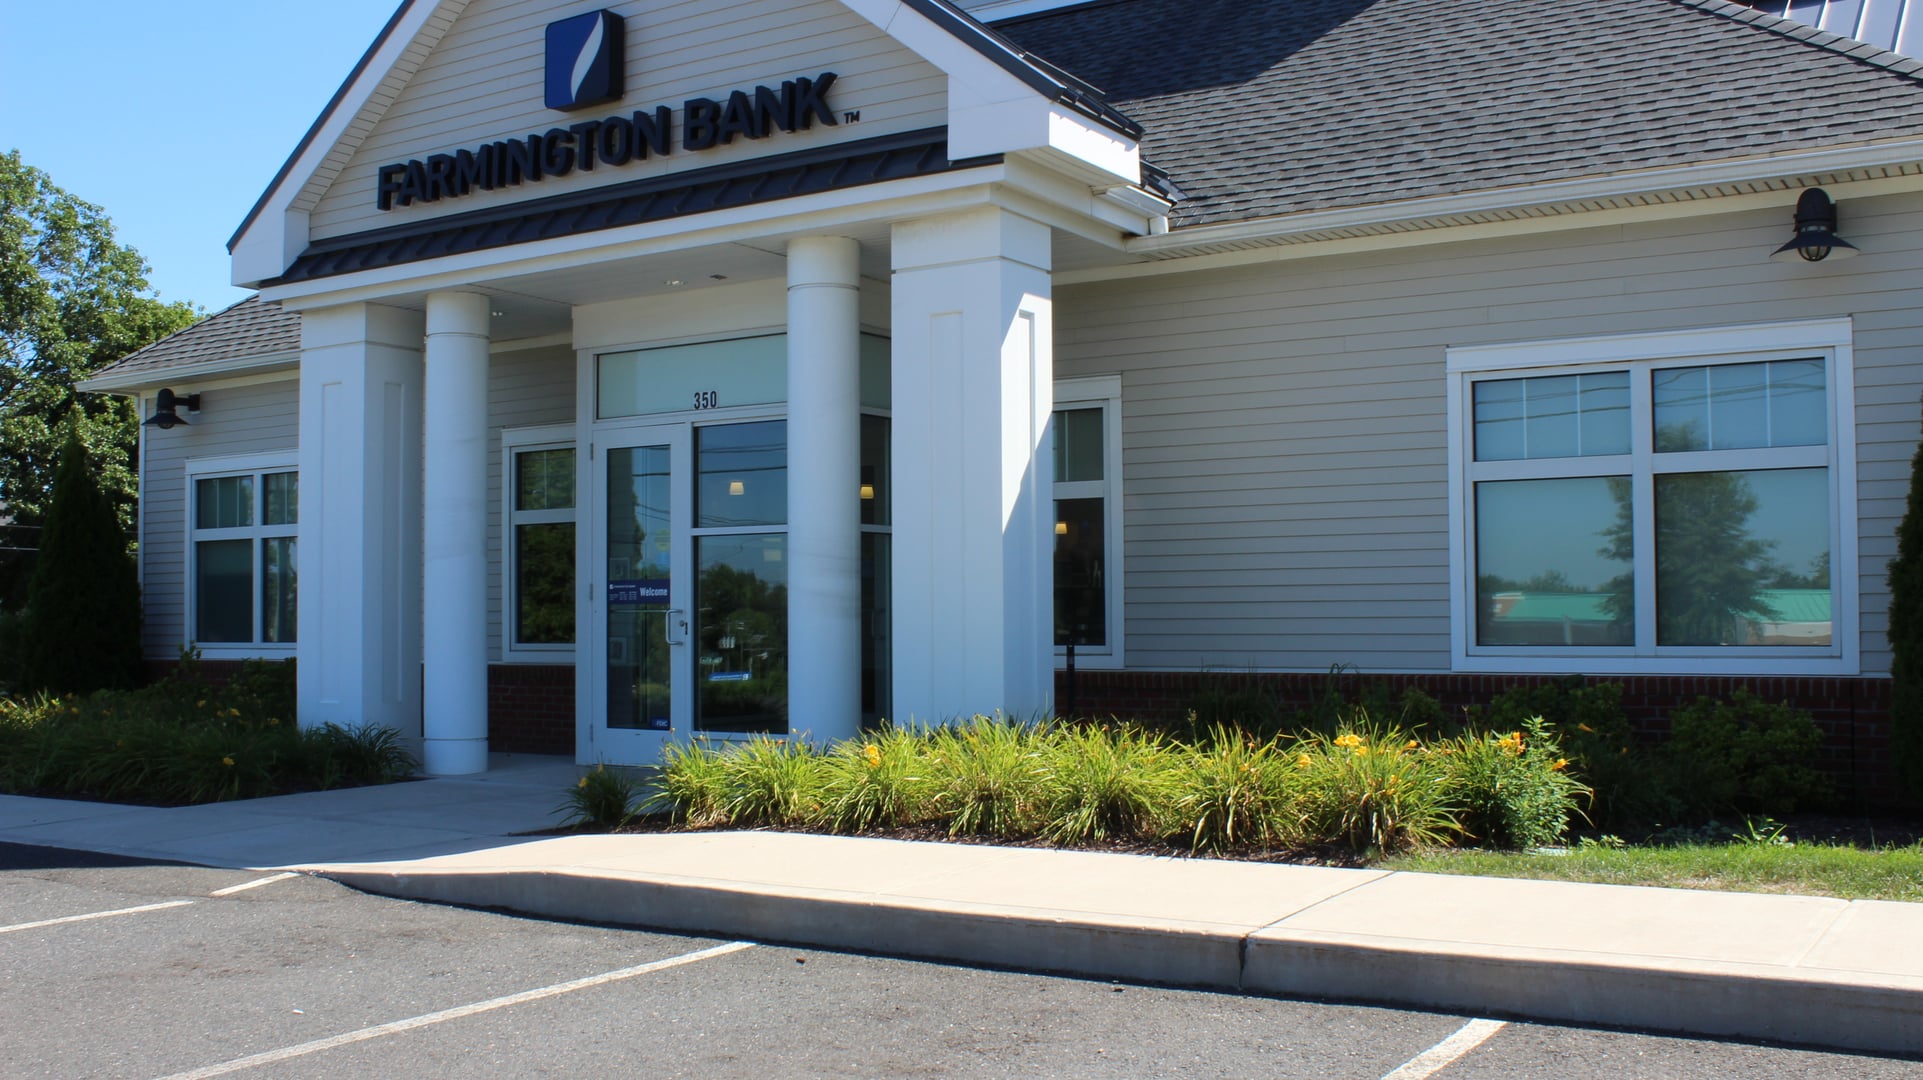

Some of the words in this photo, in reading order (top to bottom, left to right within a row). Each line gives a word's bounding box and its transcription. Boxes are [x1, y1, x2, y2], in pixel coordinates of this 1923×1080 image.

[377, 105, 671, 211] FARMINGTON
[683, 72, 838, 151] BANK
[694, 390, 717, 410] 350
[640, 587, 668, 597] Welcome
